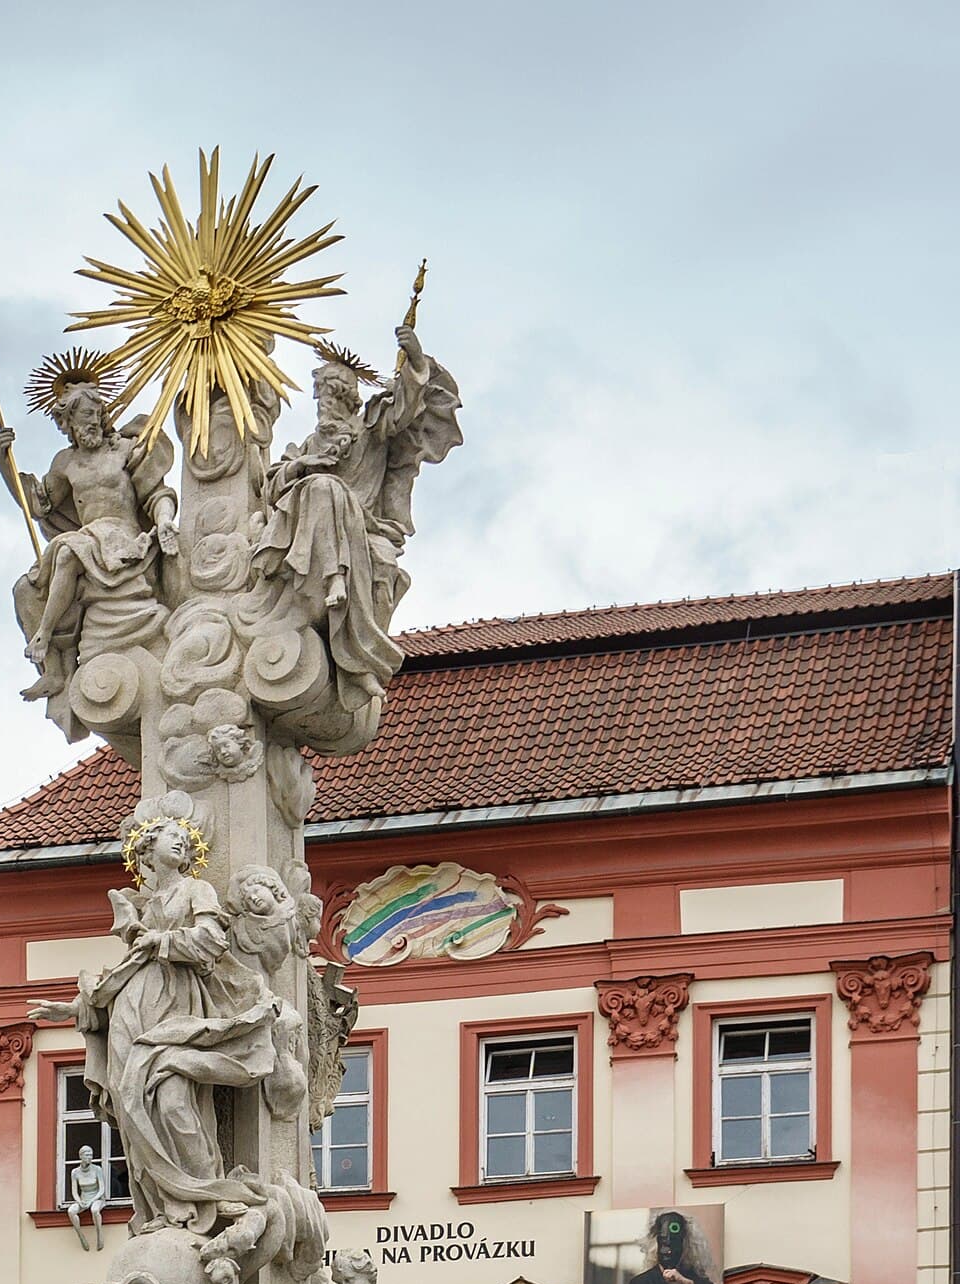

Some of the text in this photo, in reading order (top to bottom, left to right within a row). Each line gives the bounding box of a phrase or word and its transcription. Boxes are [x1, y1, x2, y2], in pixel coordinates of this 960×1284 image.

[376, 1222, 475, 1243] DIVADLO
[381, 1247, 412, 1265] NA
[419, 1238, 536, 1263] PROVÁZKU
